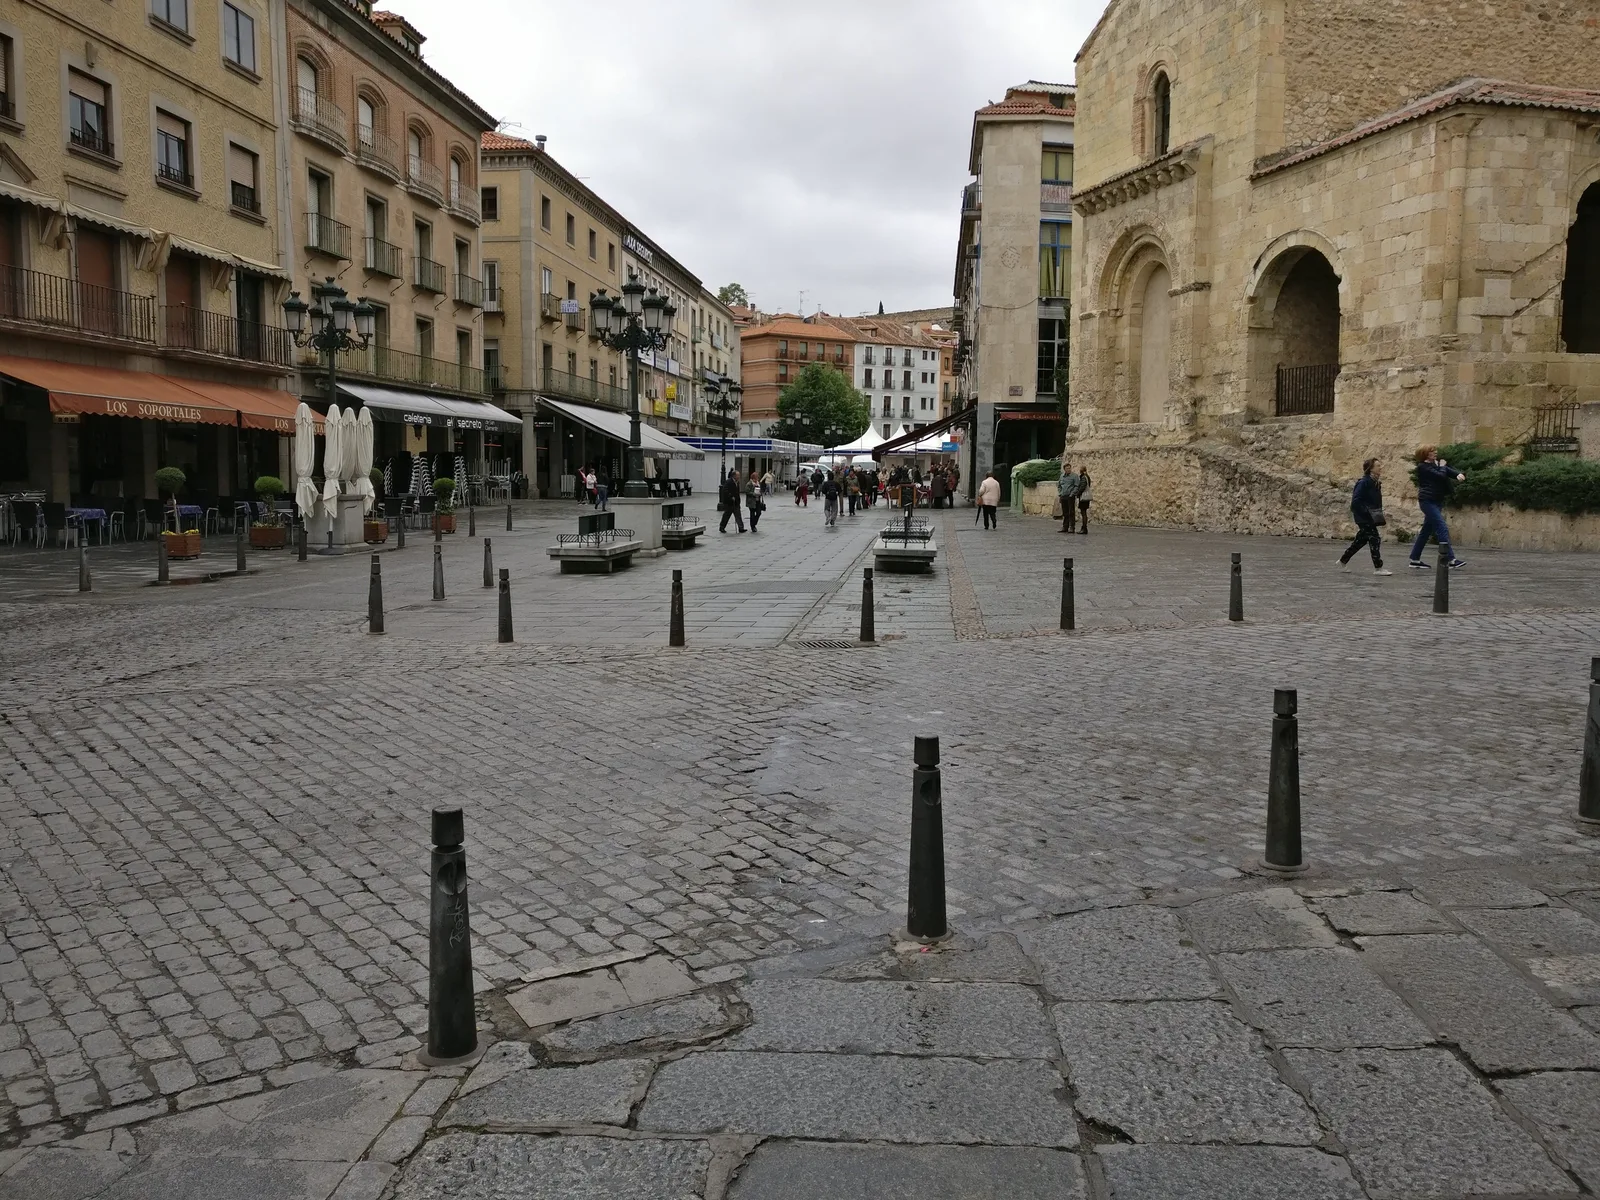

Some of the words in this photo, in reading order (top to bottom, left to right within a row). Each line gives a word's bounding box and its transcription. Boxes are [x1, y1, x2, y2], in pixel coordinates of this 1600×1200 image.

[626, 234, 636, 252] AXA
[636, 241, 653, 263] SEGUROS
[106, 400, 128, 414] LOS
[138, 403, 202, 421] SOPORTALES
[274, 418, 289, 430] LOS
[403, 412, 432, 425] cafeteria
[457, 418, 482, 429] secreto
